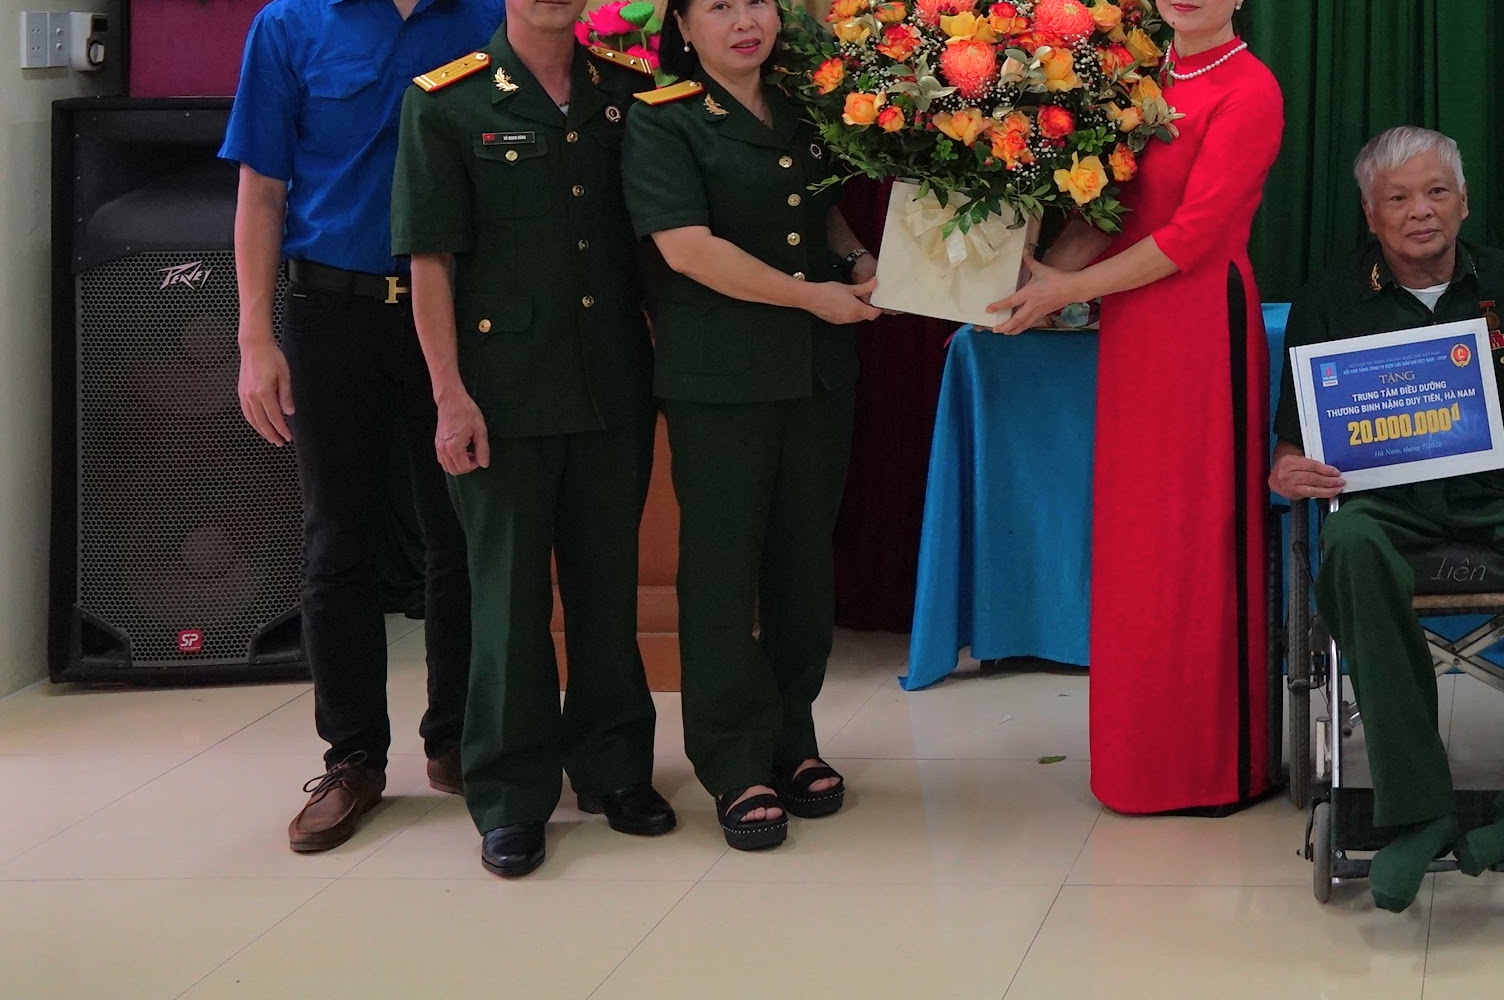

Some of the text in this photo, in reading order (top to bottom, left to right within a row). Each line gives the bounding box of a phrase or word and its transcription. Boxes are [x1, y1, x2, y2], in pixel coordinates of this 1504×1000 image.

[1326, 405, 1360, 418] THƯƠNG
[1361, 402, 1381, 413] BINH
[1405, 396, 1421, 407] DUY
[1444, 389, 1456, 400] HÀ
[1457, 388, 1476, 398] NAM
[1352, 391, 1379, 402] TRUNG
[1380, 387, 1398, 398] TÂM
